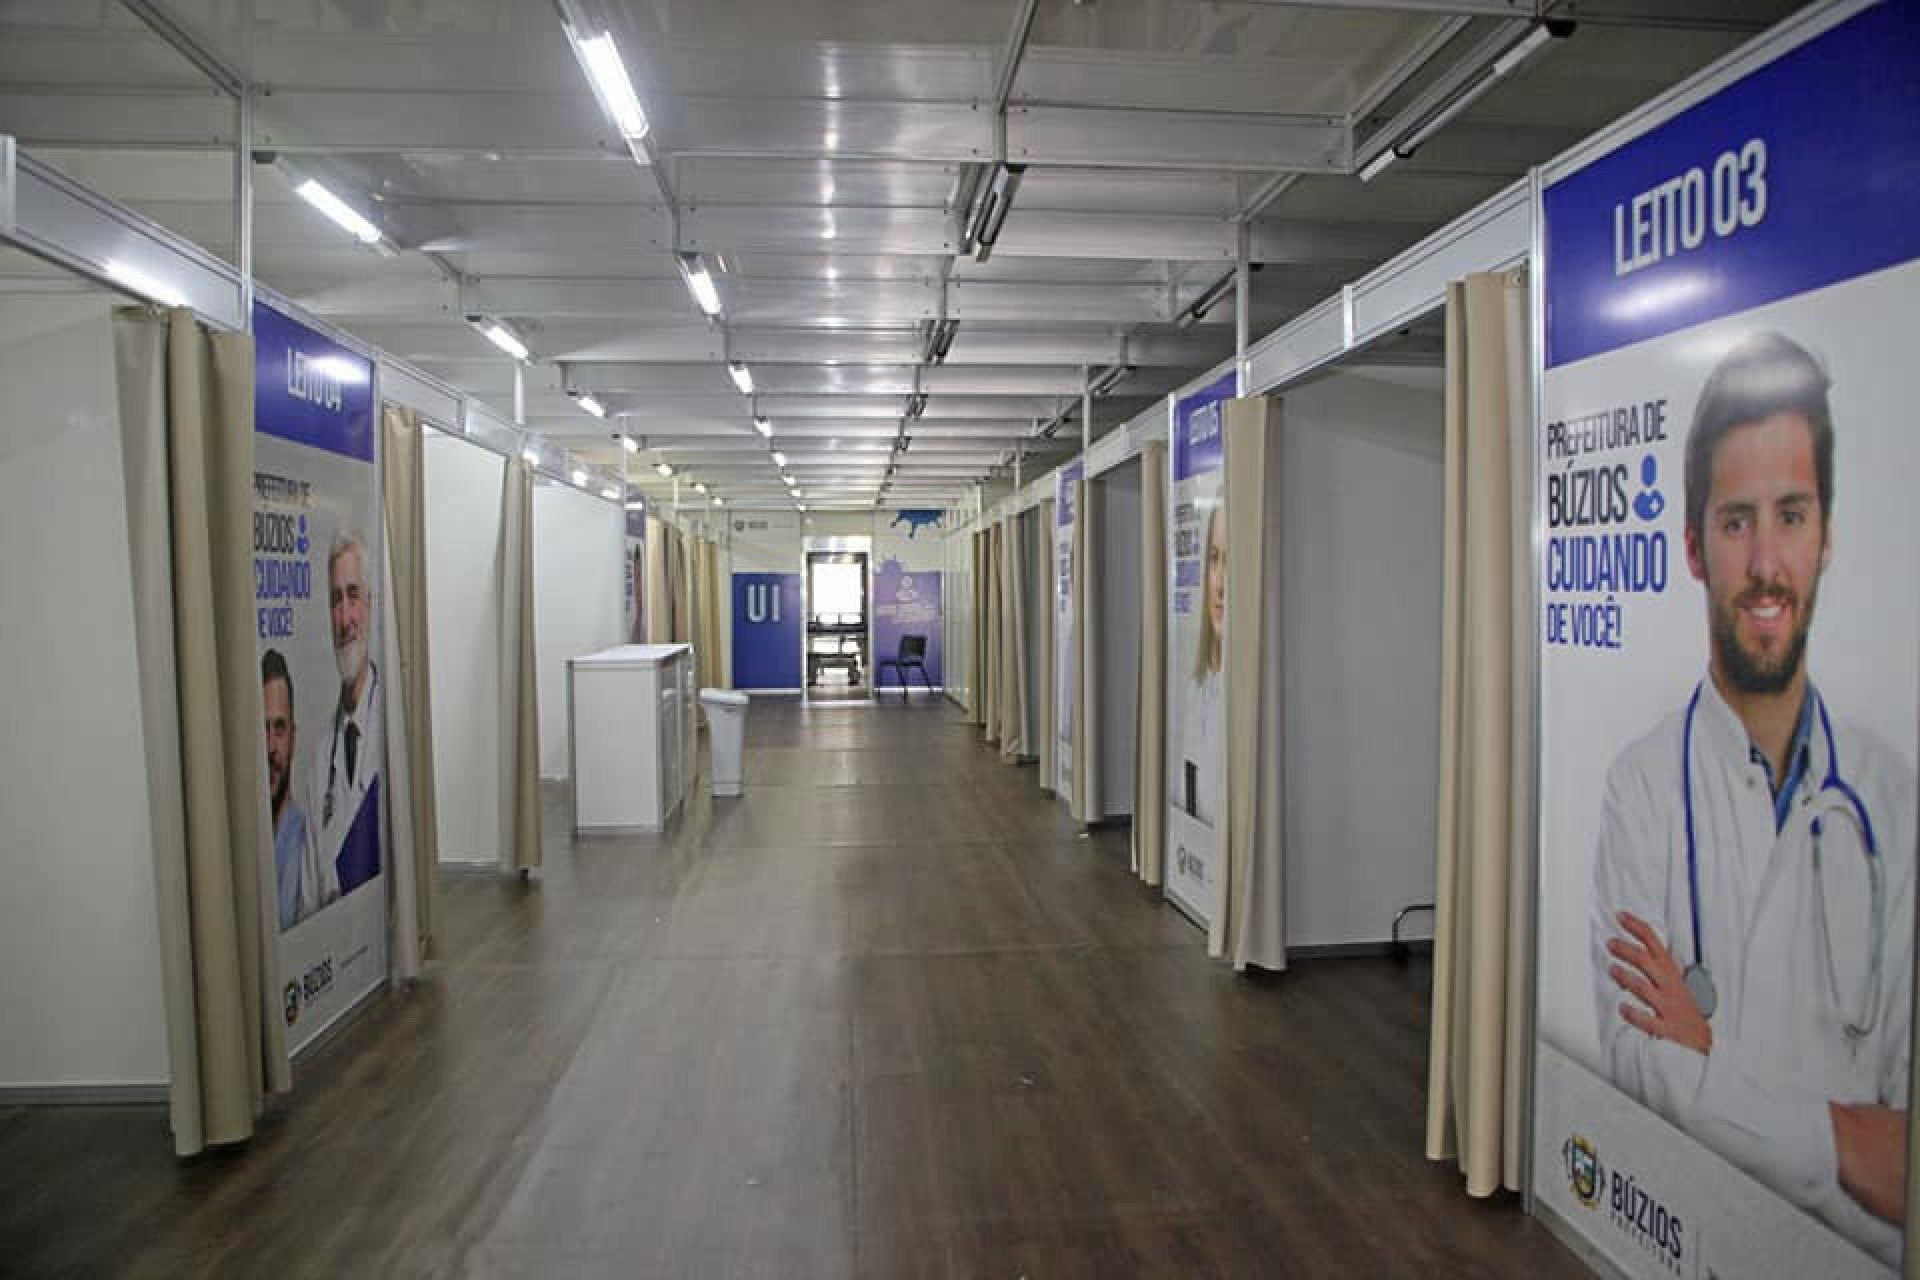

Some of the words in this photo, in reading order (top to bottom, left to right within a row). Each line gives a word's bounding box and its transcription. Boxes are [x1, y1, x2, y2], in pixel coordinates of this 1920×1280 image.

[1615, 167, 1705, 276] LEITO
[1714, 138, 1767, 236] 03
[1547, 406, 1641, 460] PREFEITURA
[1644, 399, 1667, 442] DE
[1548, 459, 1628, 528] BÚZIOS
[1548, 531, 1667, 593] CUIDANDO
[1547, 603, 1568, 644] DE
[1569, 594, 1622, 649] VOCÊ!
[1612, 1169, 1683, 1259] BÚZIOS
